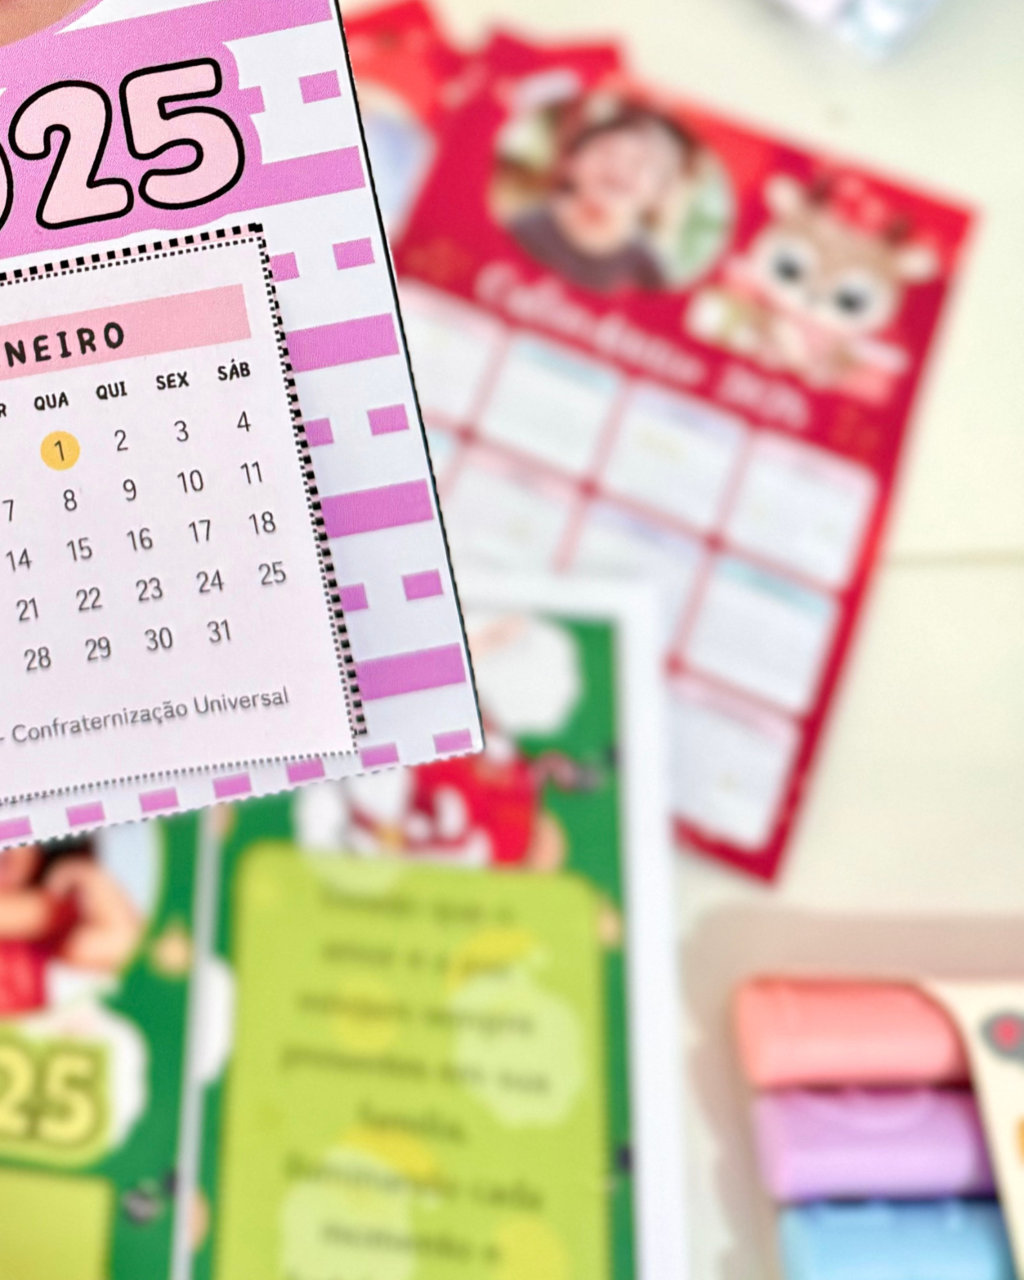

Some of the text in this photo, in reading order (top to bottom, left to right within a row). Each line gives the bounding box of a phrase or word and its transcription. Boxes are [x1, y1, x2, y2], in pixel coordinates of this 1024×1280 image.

[33, 391, 70, 412] QUA
[95, 380, 128, 401] QUI
[155, 370, 190, 391] SEX
[217, 358, 251, 382] SÁB
[54, 410, 252, 462] 1 2 3 4
[2, 498, 15, 523] 7
[62, 488, 78, 513] 8
[122, 478, 137, 503] 9
[177, 469, 205, 494] 10
[240, 460, 263, 485] 11
[6, 547, 33, 572] 14
[66, 537, 93, 562] 15
[126, 527, 154, 552] 16
[188, 518, 211, 544] 17
[248, 510, 277, 536] 18
[15, 597, 39, 623] 21
[75, 586, 103, 613] 22
[135, 577, 164, 603] 23
[196, 569, 225, 595] 24
[258, 561, 287, 587] 25
[23, 646, 52, 673] 28
[84, 636, 112, 662] 29
[144, 626, 174, 652] 30
[206, 619, 232, 644] 31
[11, 700, 188, 744] Confraternização
[193, 686, 290, 715] Universal
